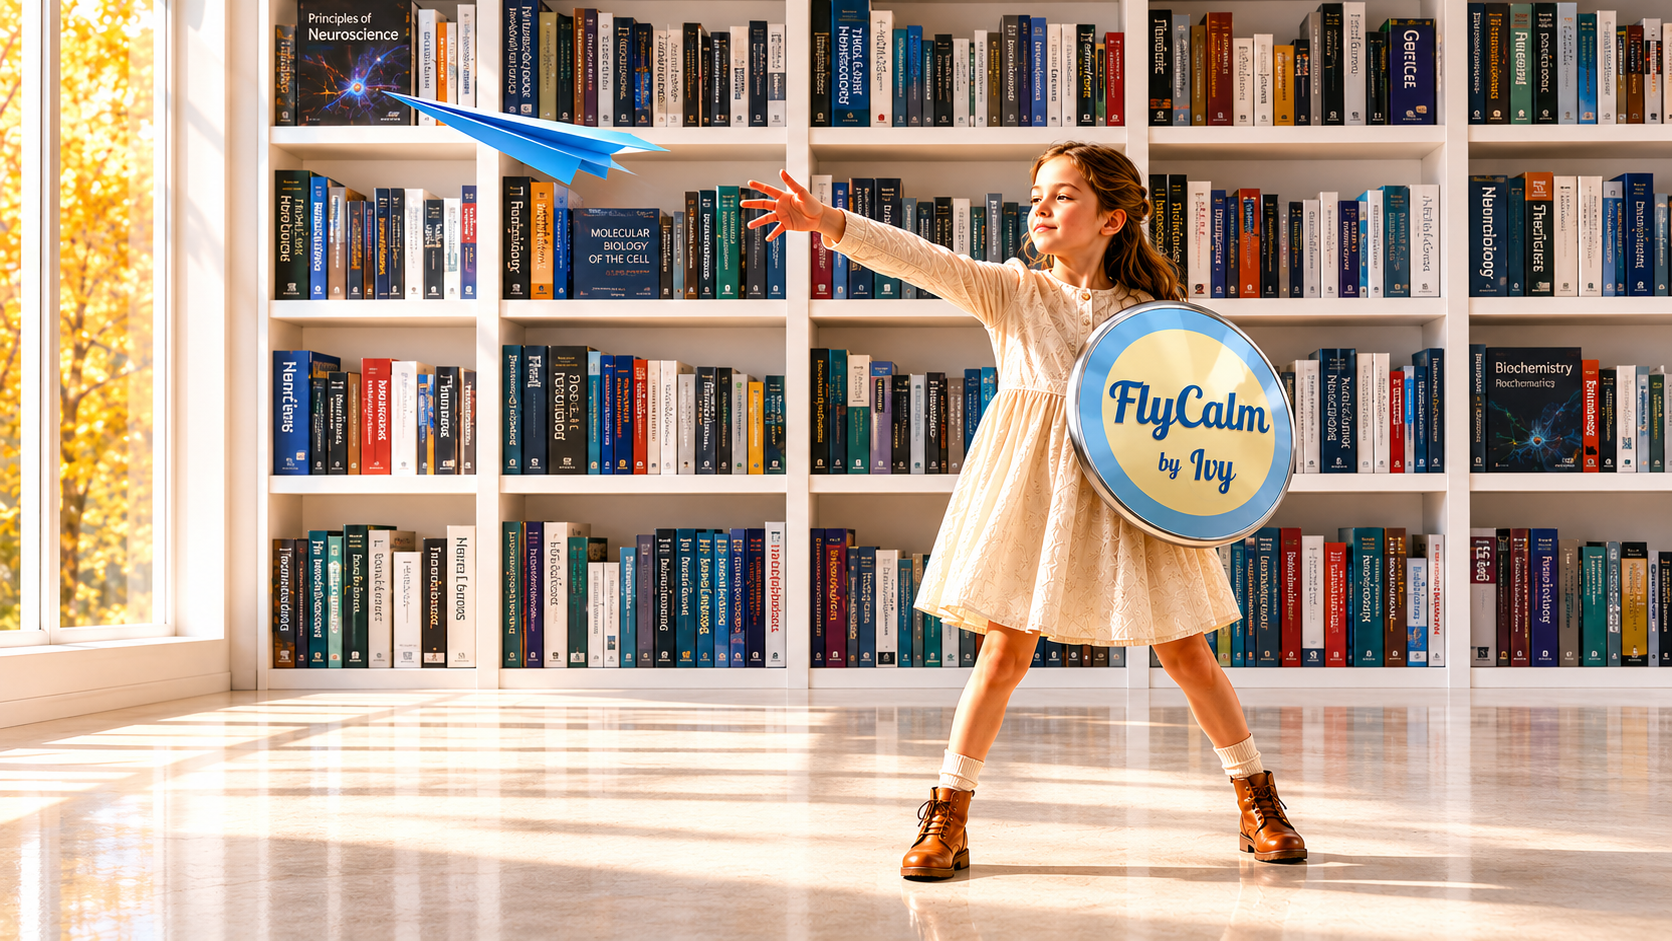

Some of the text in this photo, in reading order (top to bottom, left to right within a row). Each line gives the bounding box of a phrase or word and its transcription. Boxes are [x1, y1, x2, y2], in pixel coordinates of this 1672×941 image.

[308, 12, 372, 26] Principles of
[308, 28, 399, 41] Neuroscience
[591, 228, 650, 238] MOLECULAR
[603, 241, 649, 251] BIOLOGY
[588, 254, 650, 264] OF THE CELL
[1495, 361, 1573, 376] Biochemistry
[1108, 379, 1270, 441] FlyCalm
[1158, 448, 1237, 494] by Ivy
